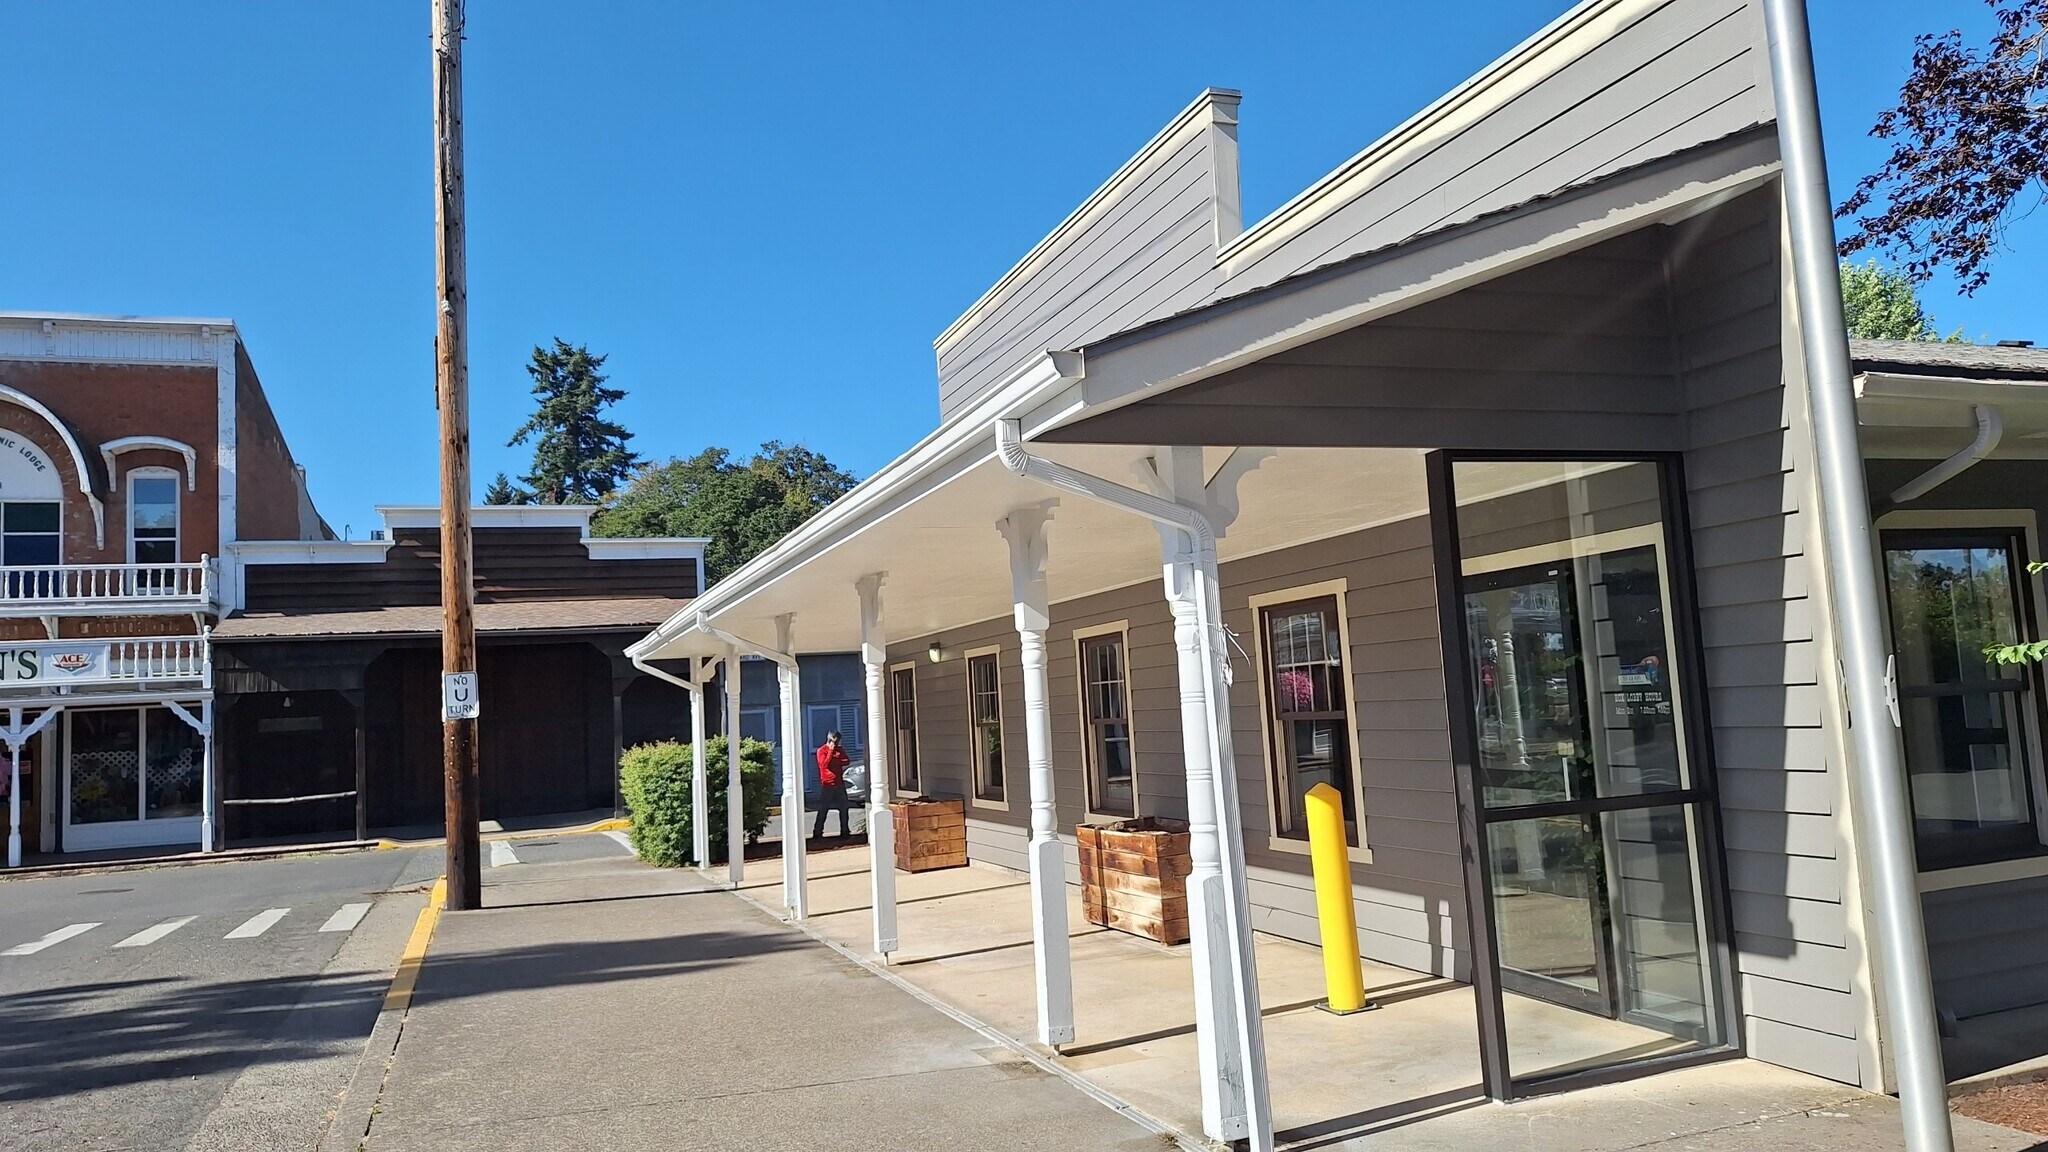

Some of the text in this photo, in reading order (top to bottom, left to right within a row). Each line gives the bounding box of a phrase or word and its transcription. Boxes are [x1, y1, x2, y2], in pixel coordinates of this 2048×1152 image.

[19, 447, 46, 472] LODGE
[60, 654, 84, 663] ACE
[454, 676, 468, 686] NO
[455, 688, 468, 702] U
[1626, 693, 1643, 702] LOBBY
[1644, 692, 1662, 701] HOURS
[449, 704, 476, 714] TURN
